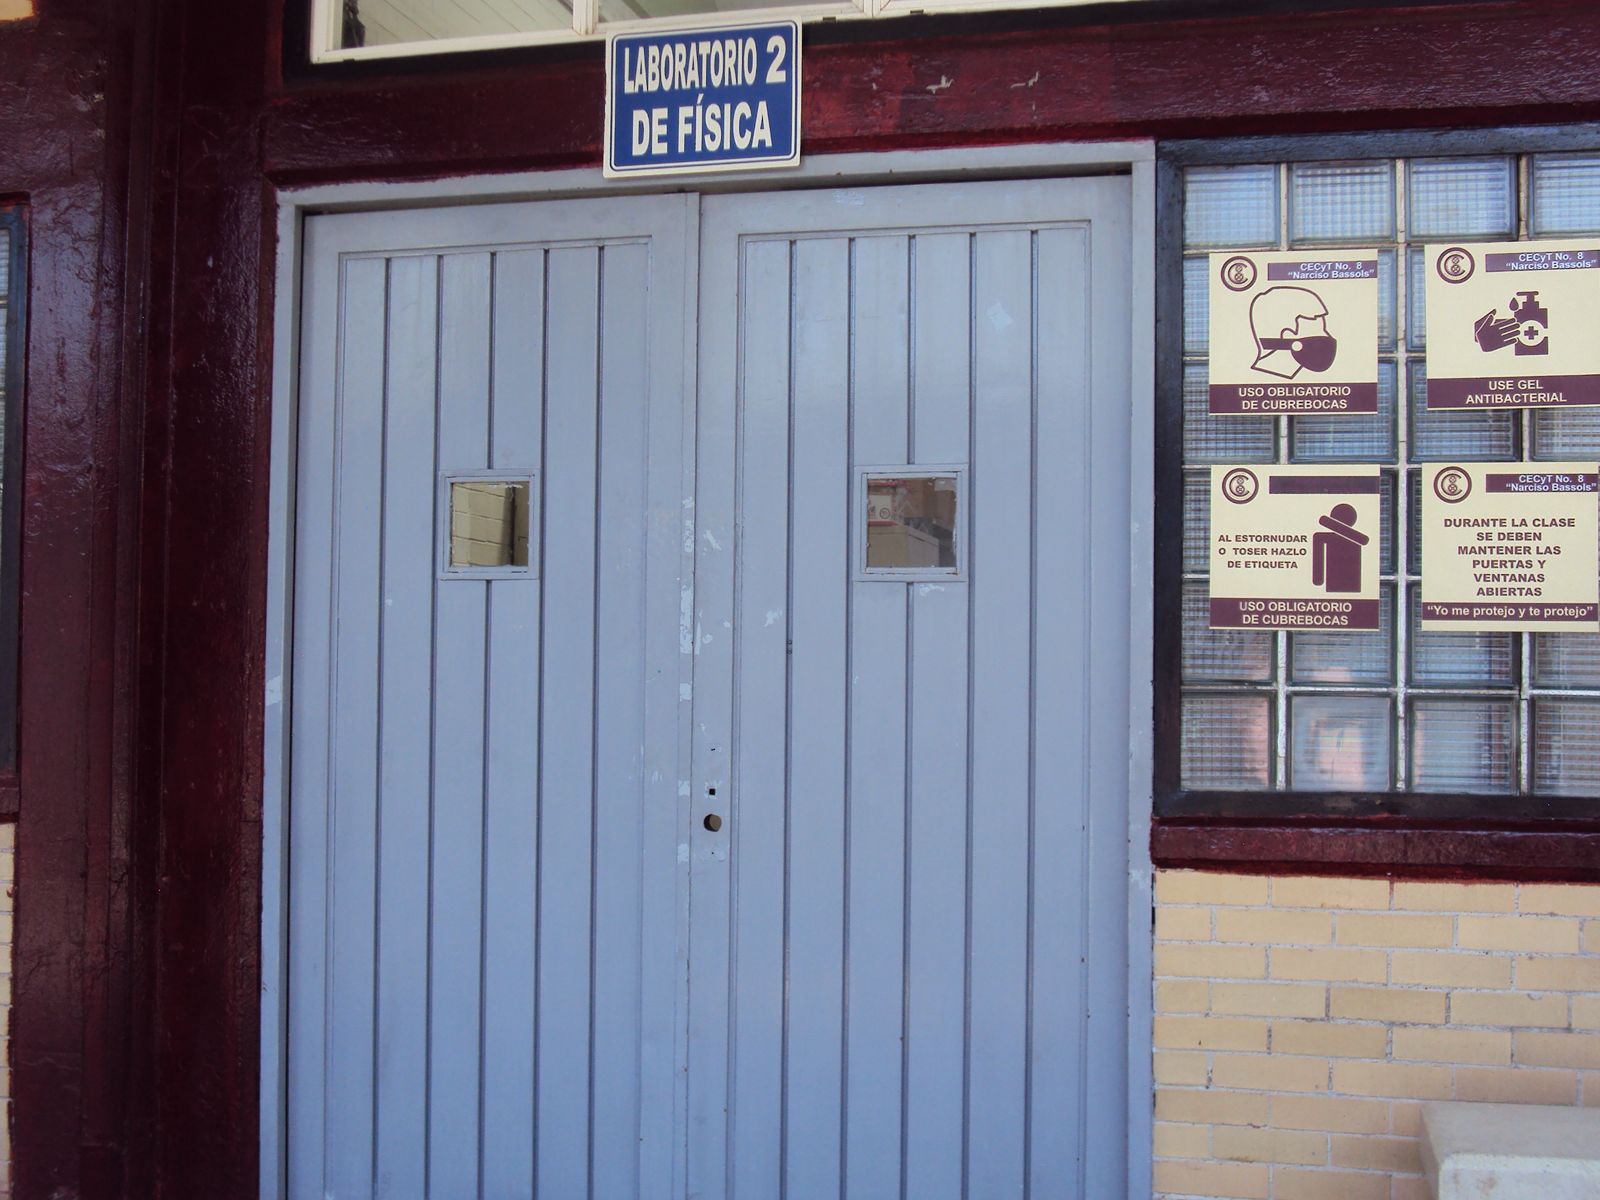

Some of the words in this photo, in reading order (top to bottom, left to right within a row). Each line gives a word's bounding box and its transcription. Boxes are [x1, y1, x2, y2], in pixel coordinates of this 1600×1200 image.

[624, 37, 757, 94] LABORATORIO
[766, 35, 786, 84] 2
[632, 107, 668, 156] DE
[678, 94, 772, 153] FÍSICA
[1519, 253, 1551, 262] CECyT
[1555, 253, 1572, 261] No.
[1577, 252, 1583, 260] 8
[1300, 263, 1333, 272] CECyT
[1488, 380, 1514, 391] USE
[1518, 380, 1543, 390] GEL
[1239, 387, 1264, 397] USO
[1268, 386, 1351, 397] OBLIGATORIO
[1466, 393, 1567, 404] ANTIBACTERIAL
[1242, 400, 1259, 410] DE
[1262, 400, 1347, 409] CUBREBOCAS
[1519, 475, 1551, 484] CECyT
[1555, 475, 1572, 483] No.
[1444, 519, 1507, 528] DURANTE
[1512, 519, 1528, 527] LA
[1532, 518, 1575, 527] CLASE
[1476, 532, 1493, 541] SE
[1498, 532, 1542, 541] DEBEN
[1271, 548, 1307, 556] HAZLO
[1457, 546, 1532, 555] MANTENER
[1536, 546, 1561, 555] LAS
[1244, 561, 1298, 569] ETIQUETA
[1472, 559, 1533, 569] PUERTAS
[1538, 560, 1546, 568] Y
[1474, 573, 1545, 582] VENTANAS
[1476, 587, 1542, 596] ABIERTAS
[1239, 602, 1265, 612] USO
[1268, 602, 1352, 612] OBLIGATORIO
[1473, 606, 1515, 617] protejo
[1519, 608, 1525, 617] y
[1529, 606, 1540, 615] te
[1242, 615, 1259, 624] DE
[1262, 615, 1348, 625] CUBREBOCAS
